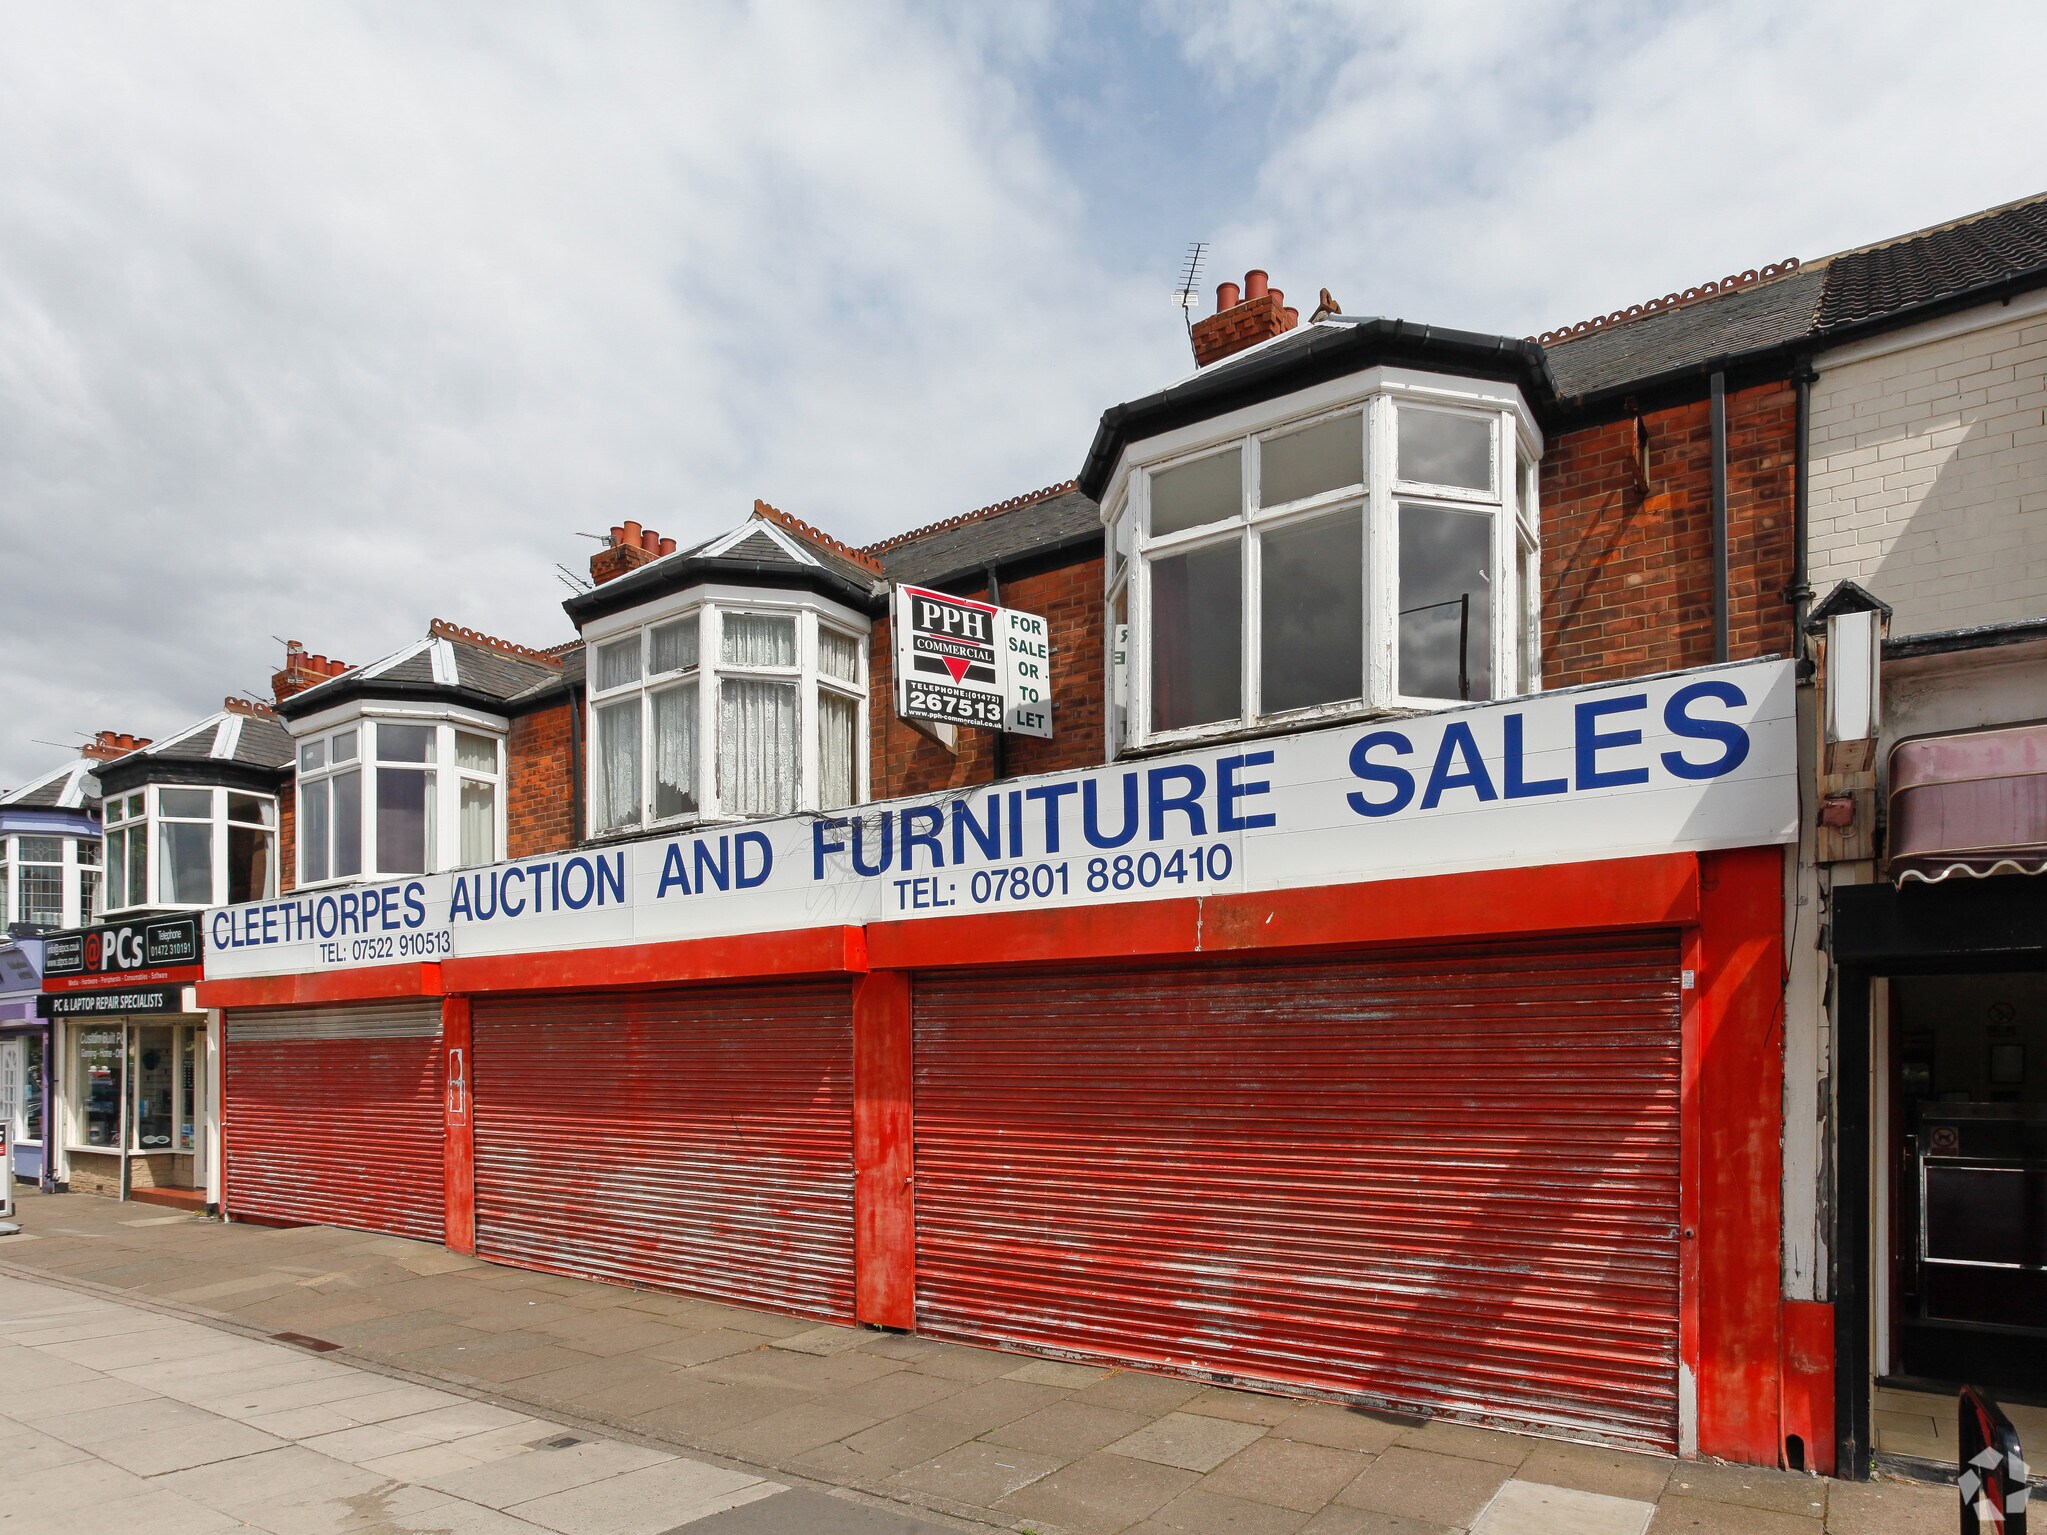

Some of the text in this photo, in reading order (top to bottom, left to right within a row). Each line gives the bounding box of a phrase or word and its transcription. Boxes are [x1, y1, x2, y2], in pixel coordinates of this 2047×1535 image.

[920, 601, 986, 640] PPH
[1011, 615, 1041, 635] FOR
[917, 638, 992, 662] COMMERCIAL
[1008, 637, 1046, 659] SALE
[1018, 661, 1039, 680] OR
[1019, 686, 1039, 703] TO
[909, 691, 1001, 721] 267513
[1016, 710, 1044, 729] LET
[212, 680, 1751, 950] CLEETHORPES AUCTION AND FURNITURE SALES
[893, 842, 1233, 911] TEL: 07801 880410
[158, 929, 182, 941] Telephone
[150, 942, 191, 957] 01472 310191
[319, 930, 451, 963] TEL: 07522 910513
[151, 971, 168, 980] Software
[53, 993, 163, 1012] PC & LAPTOP REPAIR SPECIALISTS
